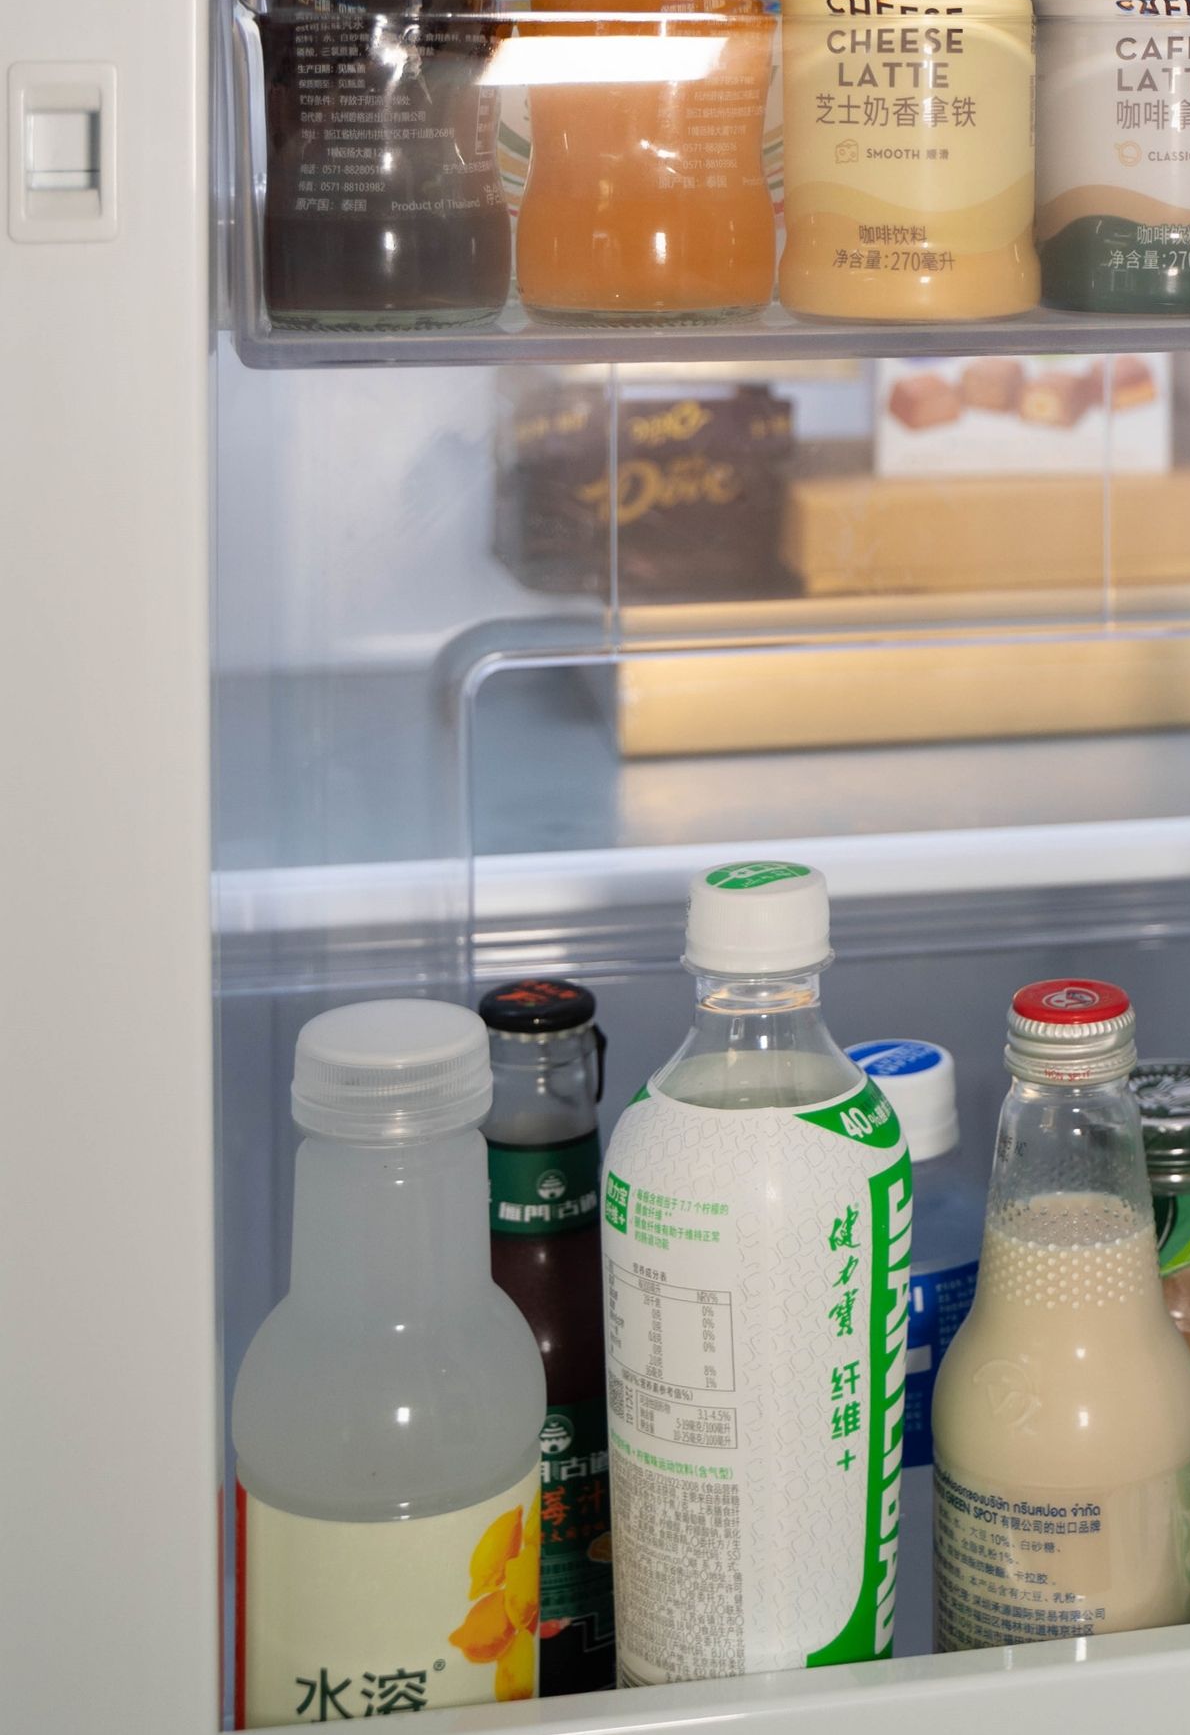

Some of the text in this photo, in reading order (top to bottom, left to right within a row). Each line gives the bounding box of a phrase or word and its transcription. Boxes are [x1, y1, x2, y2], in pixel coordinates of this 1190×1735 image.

[826, 27, 964, 54] CHEESE
[838, 62, 949, 88] LATTE
[816, 93, 977, 129] 芝士奶香拿铁
[866, 148, 920, 160] SMOOTH
[858, 225, 928, 246] 咖啡饮料
[296, 1667, 429, 1722] 水溶
